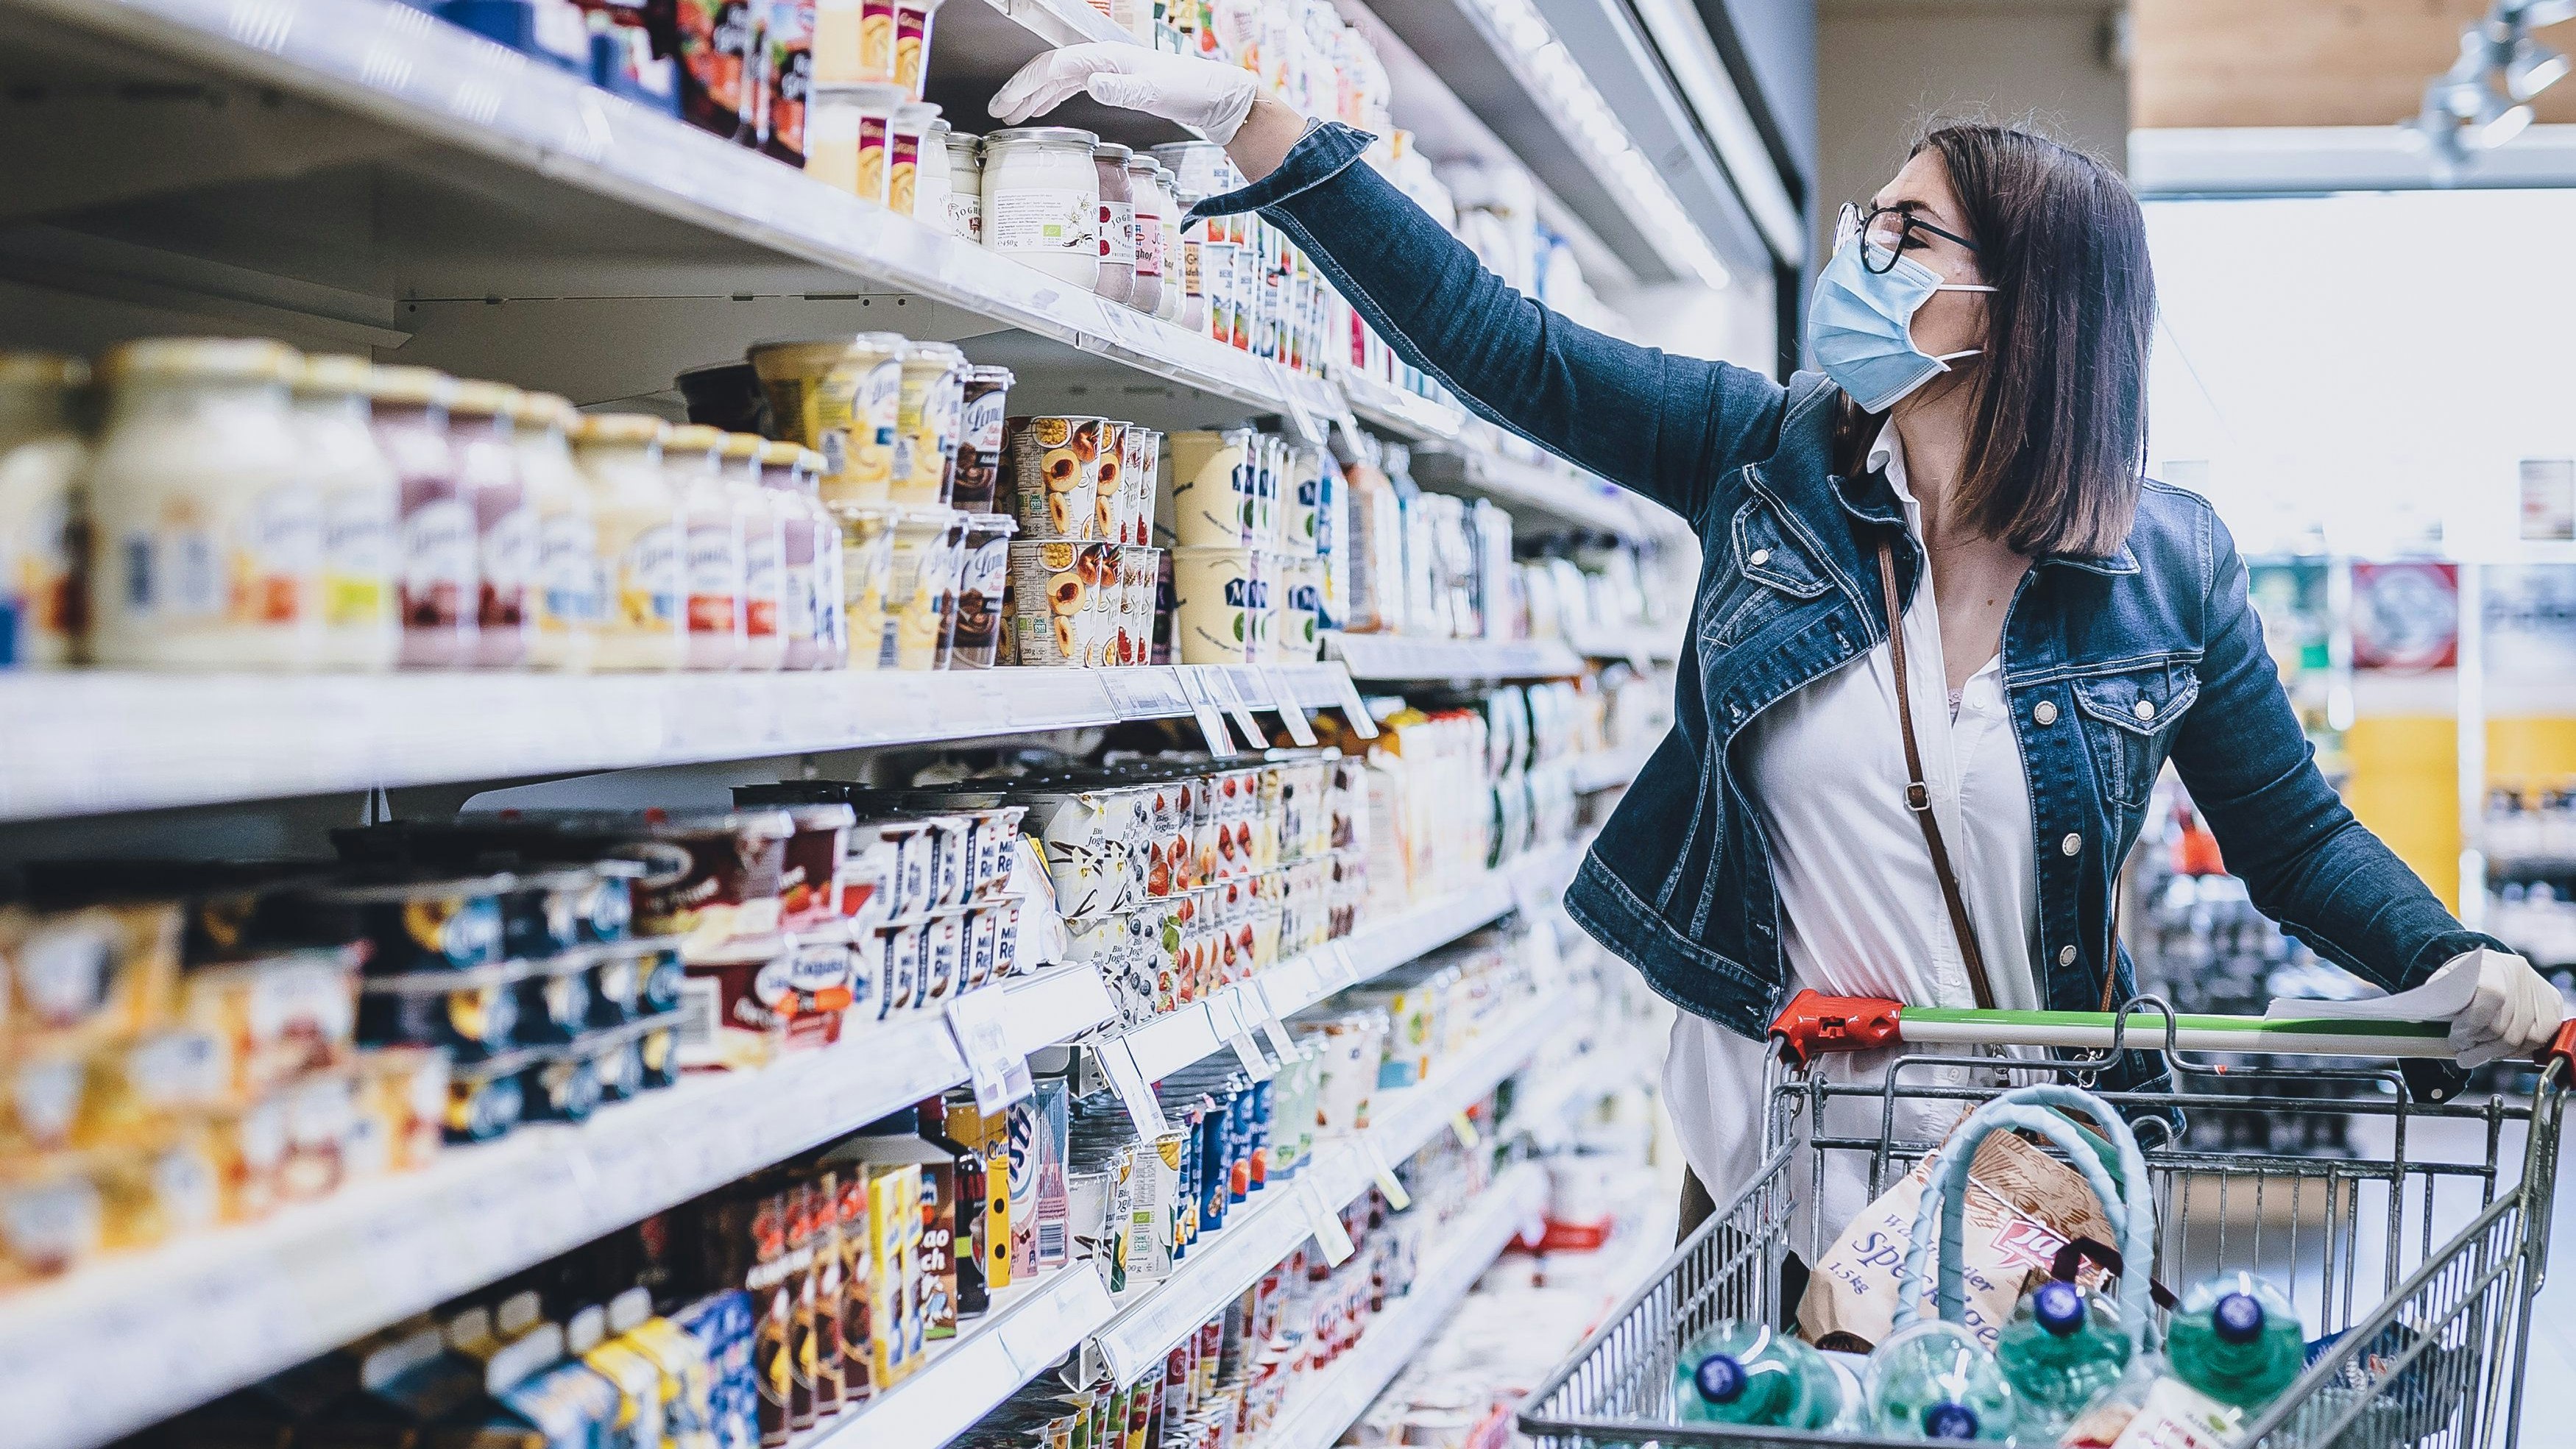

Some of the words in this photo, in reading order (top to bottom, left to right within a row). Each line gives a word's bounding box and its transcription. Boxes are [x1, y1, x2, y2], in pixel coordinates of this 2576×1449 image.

[1093, 827, 1103, 835] Bio
[1112, 945, 1123, 953] Bio
[1117, 1189, 1130, 1199] Bio
